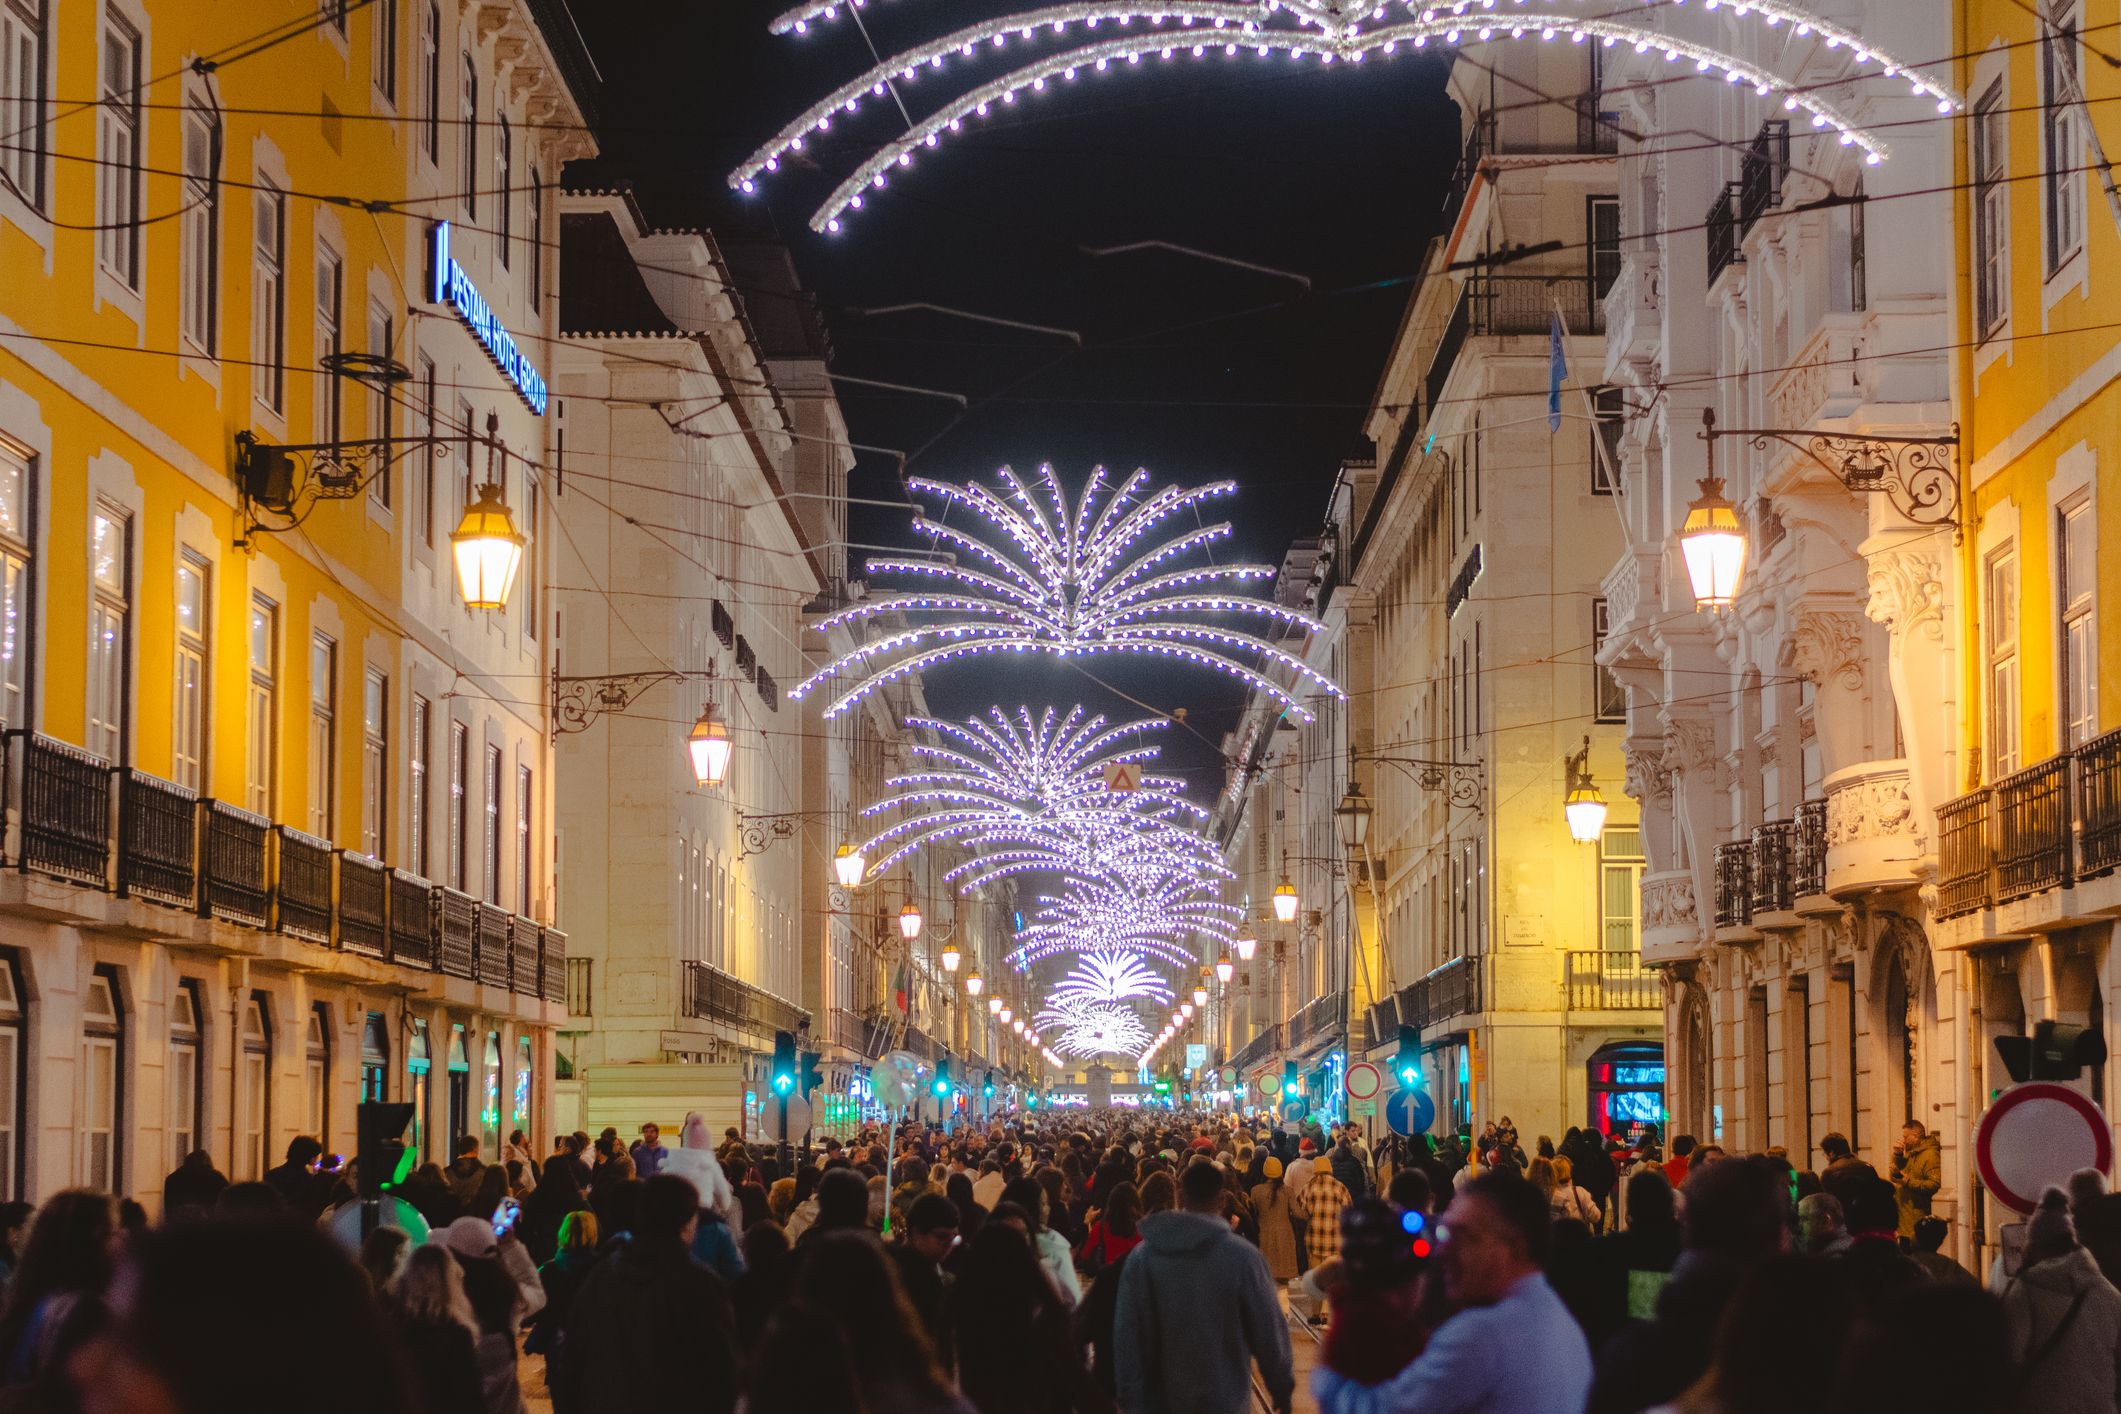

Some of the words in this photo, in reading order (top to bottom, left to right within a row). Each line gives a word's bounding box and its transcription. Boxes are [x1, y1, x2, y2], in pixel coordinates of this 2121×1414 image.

[451, 258, 492, 349] PESTANA
[491, 314, 520, 384] HOTEL
[519, 355, 547, 417] GROUP
[1258, 832, 1267, 873] LISBOA
